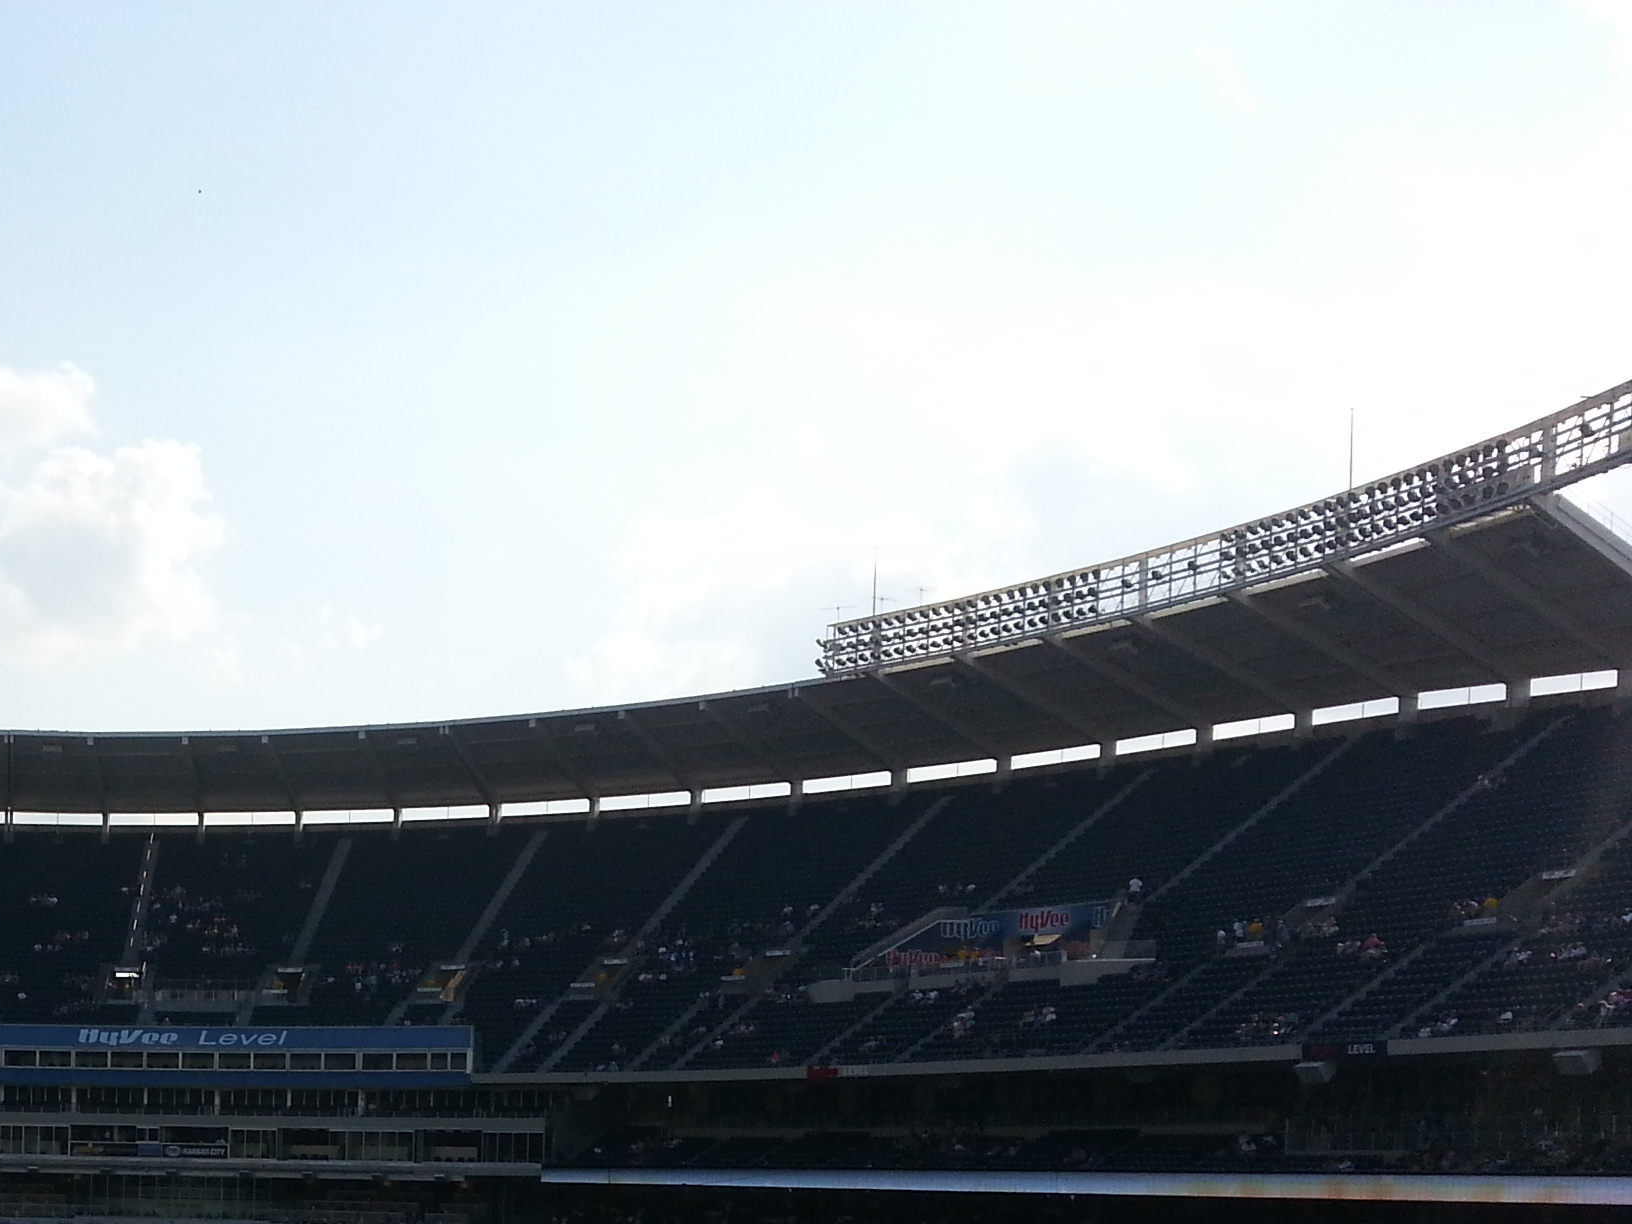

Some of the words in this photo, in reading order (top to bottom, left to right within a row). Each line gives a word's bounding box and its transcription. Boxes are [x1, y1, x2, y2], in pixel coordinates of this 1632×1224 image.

[77, 1028, 179, 1047] HyVee
[198, 1029, 289, 1046] Level
[1347, 1043, 1377, 1055] LEVEL
